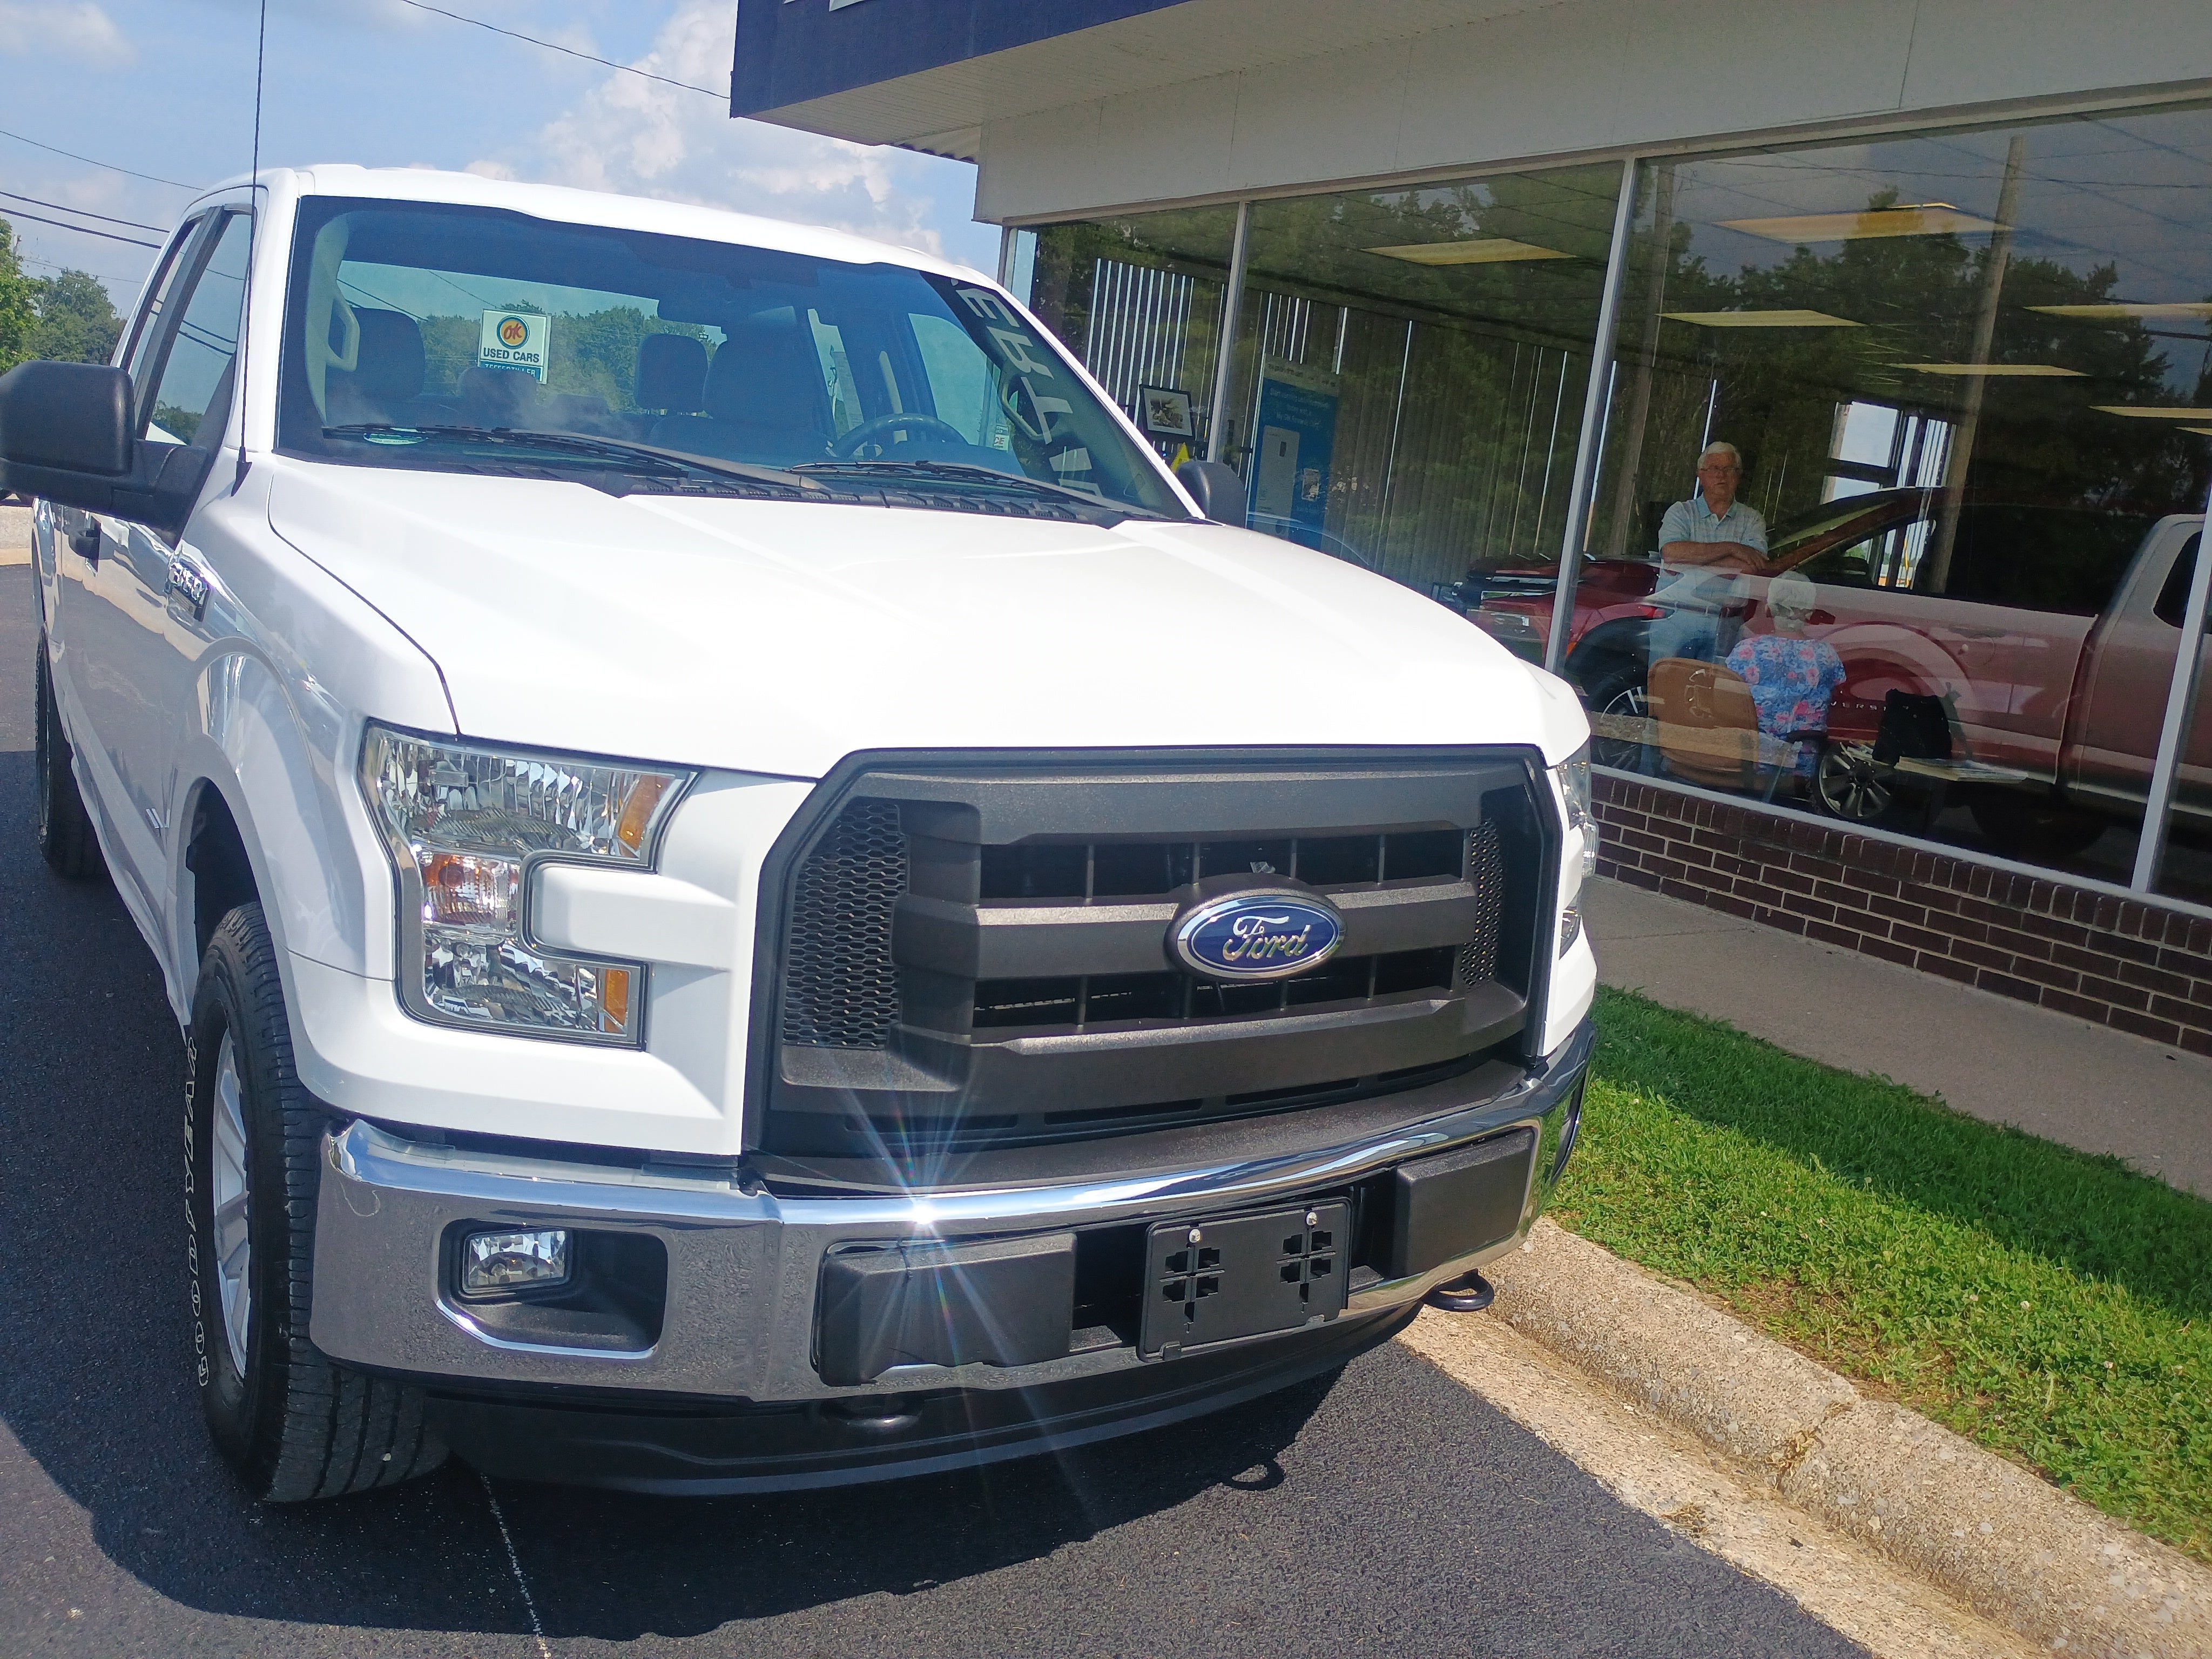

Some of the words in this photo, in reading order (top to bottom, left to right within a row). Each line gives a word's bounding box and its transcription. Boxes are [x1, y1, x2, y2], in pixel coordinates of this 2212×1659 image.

[503, 323, 523, 340] OK
[483, 347, 510, 359] USED
[513, 351, 539, 363] CARS
[1222, 915, 1311, 961] Ford
[184, 1036, 209, 1387] GOODYEAR
